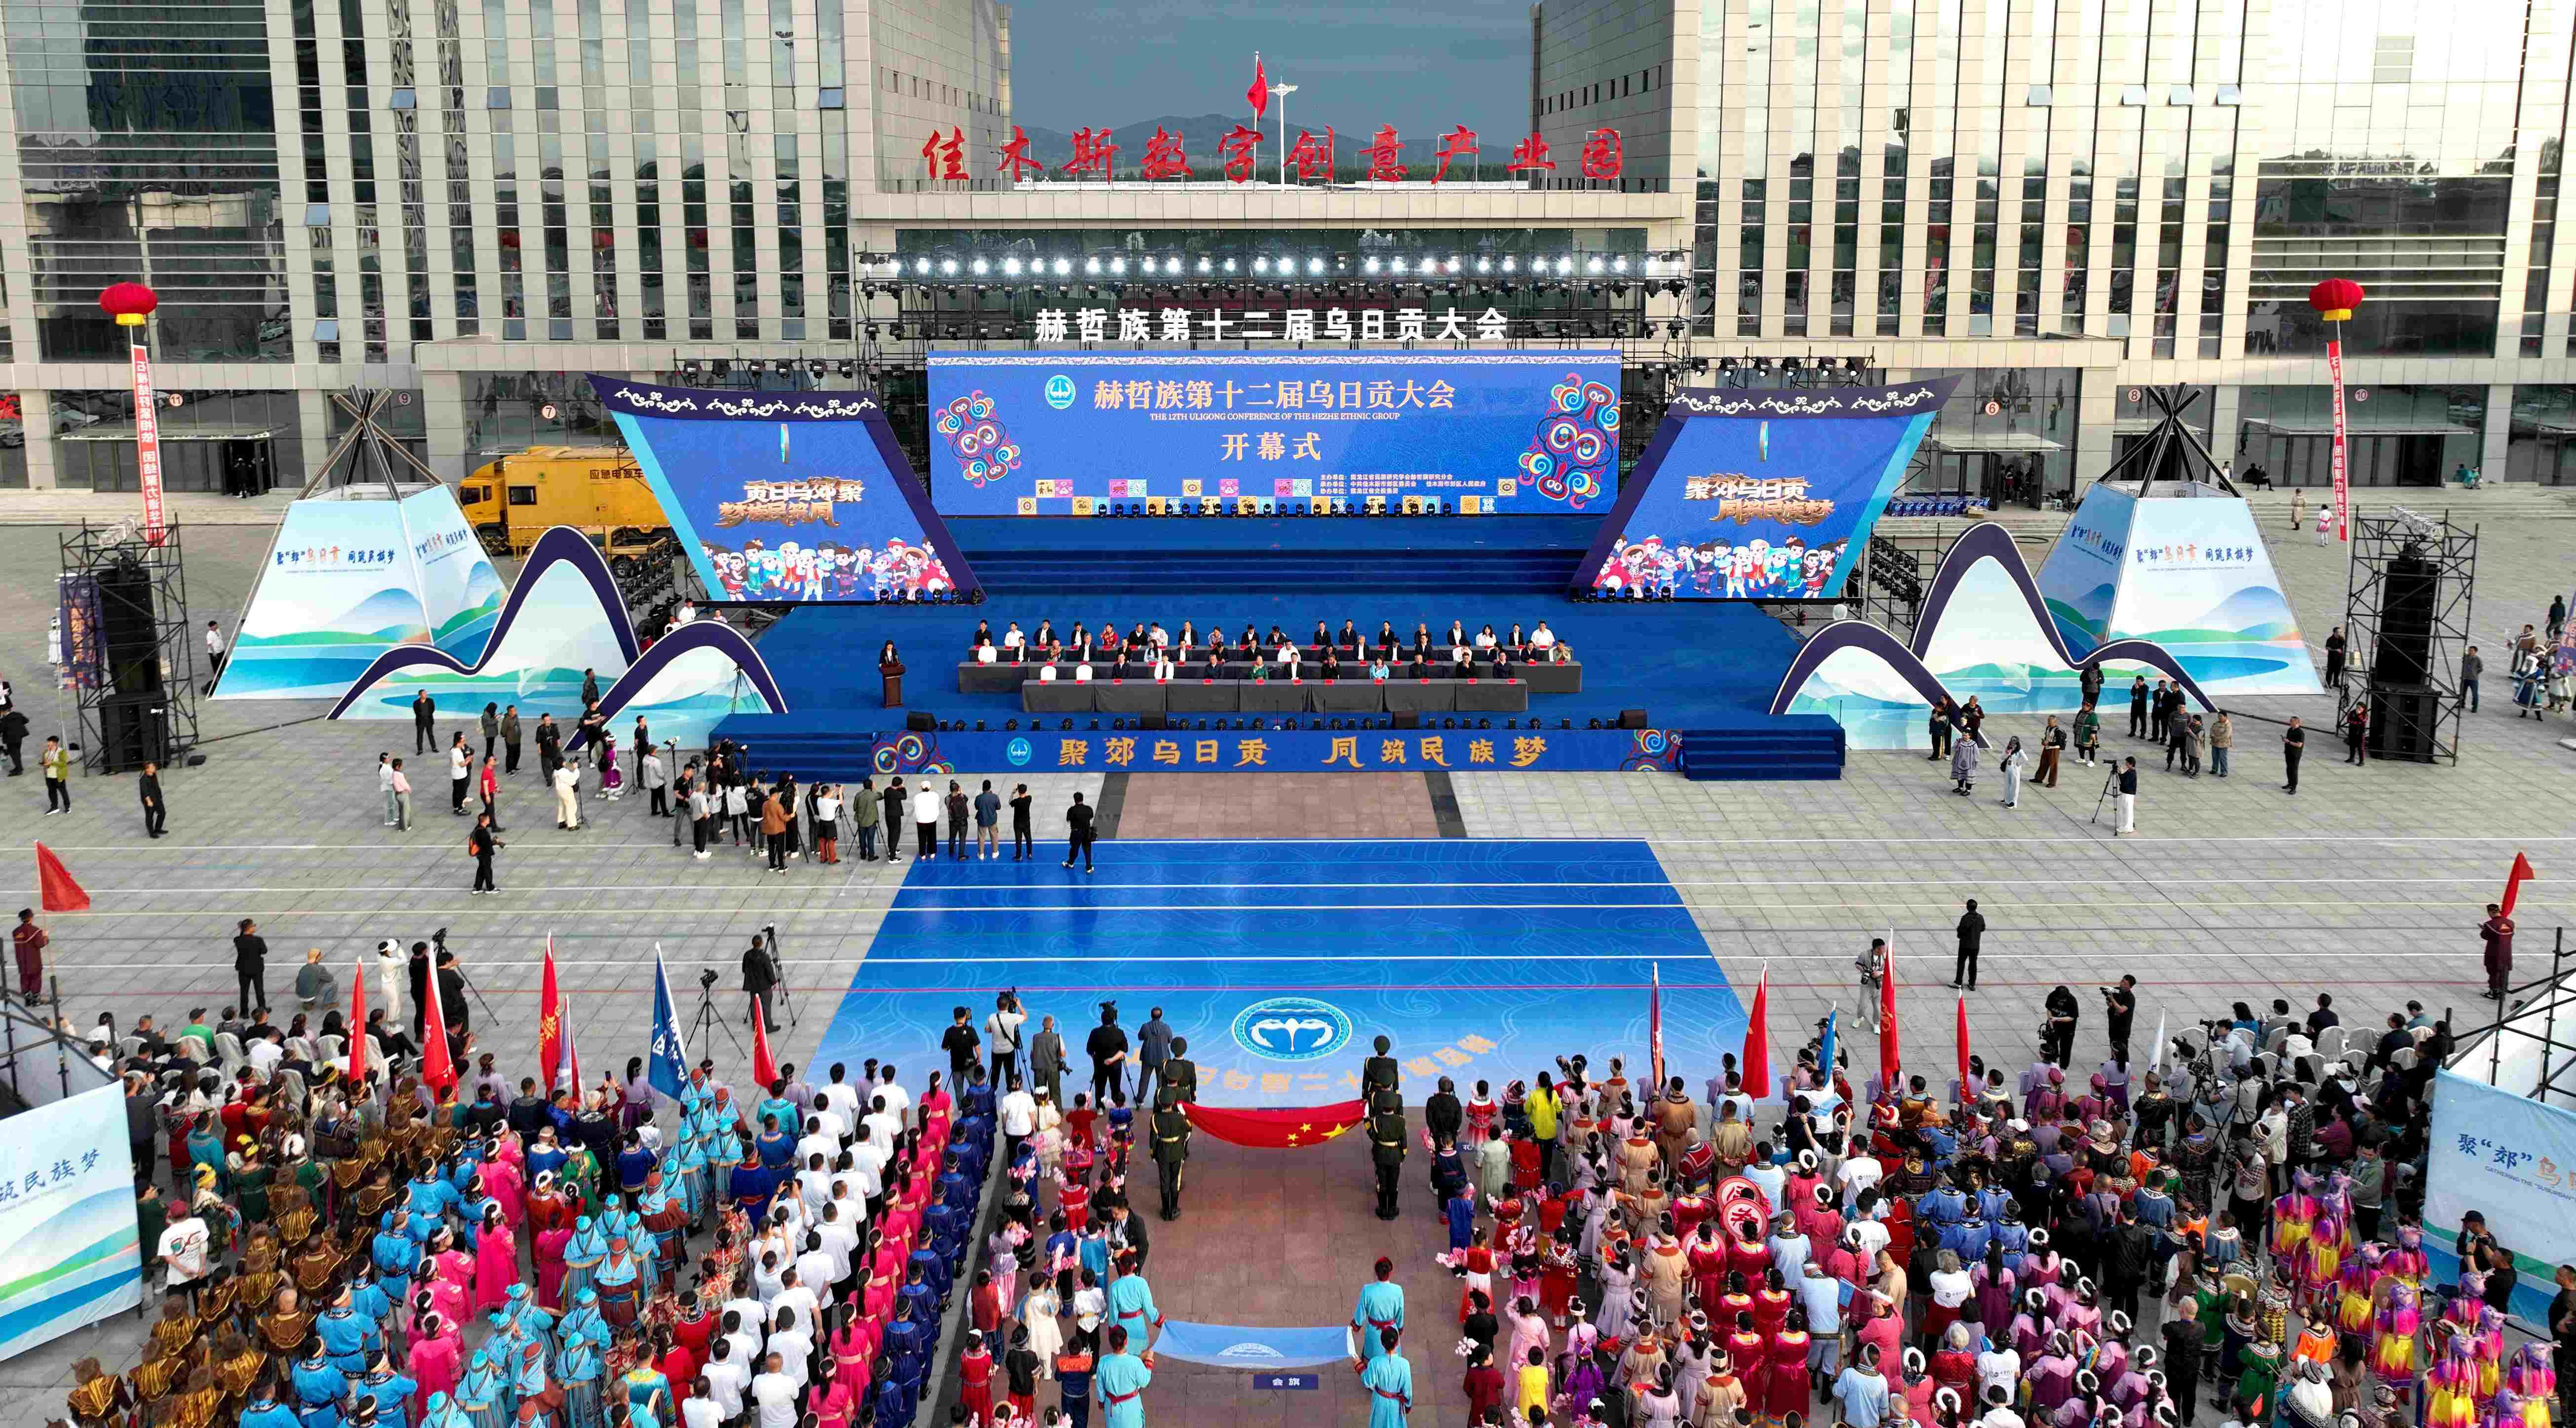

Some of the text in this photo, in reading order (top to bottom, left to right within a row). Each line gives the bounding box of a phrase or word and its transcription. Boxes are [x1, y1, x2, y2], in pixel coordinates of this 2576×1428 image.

[922, 123, 1623, 185] 佳木斯数字创意产业园
[1035, 308, 1508, 342] 赫哲族第十二届乌日贡大会
[1094, 379, 1456, 410] 赫哲族第十二届乌日贡大会
[2132, 391, 2138, 400] 8
[2358, 391, 2367, 399] 10
[546, 406, 552, 417] 7
[1989, 403, 1996, 413] 6
[1150, 412, 1400, 421] THE 12TH ULIGONG CONFERENCE OF THE HEZHE ETHNIC GROUP
[1221, 432, 1322, 462] 开幕式
[1322, 736, 1549, 768] 同筑民族梦
[1272, 1378, 1300, 1386] 会旗
